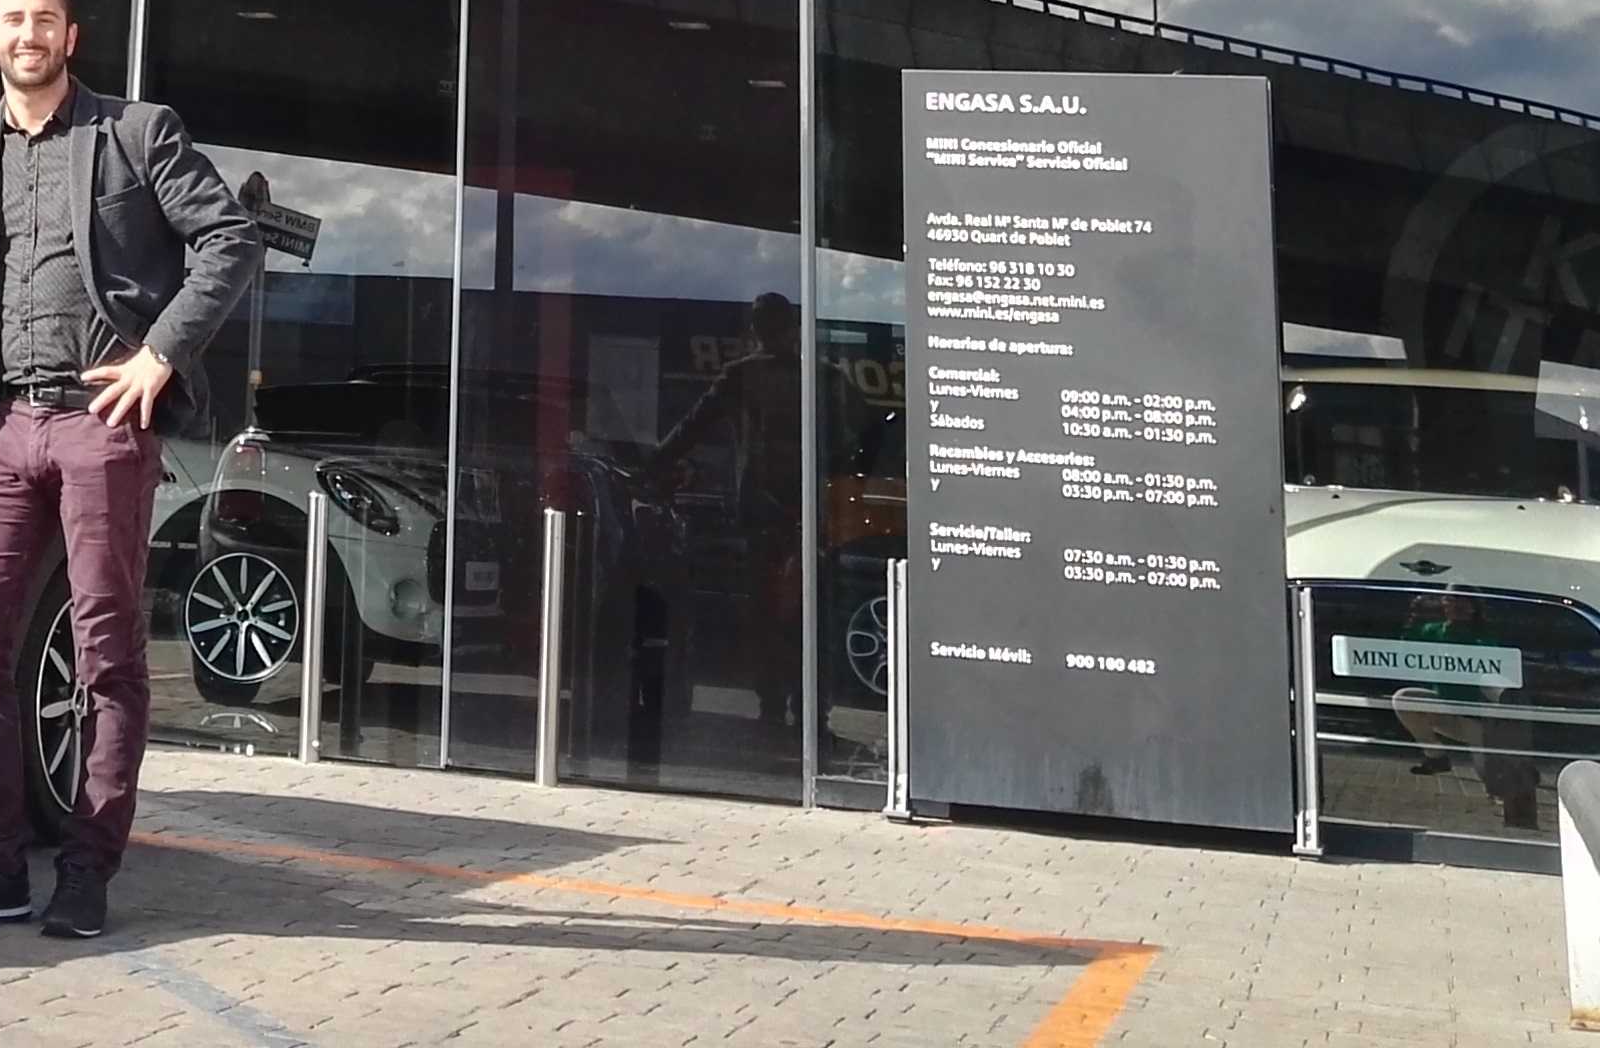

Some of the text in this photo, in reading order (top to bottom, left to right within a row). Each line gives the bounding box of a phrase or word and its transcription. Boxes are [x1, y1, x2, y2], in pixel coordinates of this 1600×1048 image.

[925, 91, 1087, 115] ENGASA S.A.U.
[925, 136, 1103, 155] MINI Concesionario Oficial
[1026, 155, 1081, 170] Servicio
[1082, 157, 1129, 171] Oficial
[926, 211, 963, 227] Avda.
[964, 213, 993, 227] Real
[1012, 215, 1050, 230] Santa
[1070, 217, 1089, 232] de
[1090, 218, 1133, 234] Poblet
[1133, 219, 1153, 233] 74
[926, 227, 1071, 247] 46930 Quart de Poblet
[927, 257, 1075, 277] Teléfono: 96 318 10 30
[927, 272, 1041, 291] Fax: 96 152 22 30
[927, 305, 1060, 325] www.mini.es/engasa
[927, 335, 1074, 356] Horarios de apertura:
[928, 365, 1001, 383] Comercial:
[928, 381, 1019, 400] Lunes-Viernes
[1060, 389, 1101, 405] 09:00
[1101, 393, 1132, 407] a.m.
[1142, 394, 1183, 409] 02:00
[1184, 398, 1217, 413] p.m.
[929, 413, 985, 430] Sábados
[1061, 405, 1101, 420] 04:00
[1101, 409, 1133, 423] p.m.
[1143, 410, 1184, 425] 08:00
[1185, 414, 1217, 428] p.m.
[1062, 422, 1101, 437] 10:30
[1102, 426, 1133, 439] a.m.
[1143, 426, 1184, 442] 01:30
[1185, 431, 1217, 445] p.m.
[929, 443, 1005, 462] Recambios
[1016, 448, 1095, 467] Accesorios:
[929, 459, 1021, 479] Lunes-Viernes
[1061, 468, 1102, 484] 08:00
[1103, 472, 1134, 486] a.m.
[1144, 473, 1185, 489] 01:30
[1186, 477, 1218, 492] p.m.
[1062, 483, 1102, 500] 03:30
[1103, 488, 1134, 503] p.m.
[1144, 488, 1186, 505] 07:00
[1186, 493, 1219, 508] p.m.
[929, 522, 1032, 543] Servicio/Taller:
[930, 538, 1022, 559] Lunes-Viernes
[1063, 548, 1104, 564] 07:30
[1104, 553, 1136, 567] a.m.
[1146, 553, 1188, 570] 01:30
[1188, 559, 1221, 573] p.m.
[1064, 565, 1104, 582] 03:30
[1105, 570, 1137, 585] p.m.
[1147, 571, 1188, 587] 07:00
[1189, 576, 1221, 591] p.m.
[930, 641, 1156, 675] Servicio Móvil: 900 100 482
[1353, 650, 1502, 675] MINI CLUBMAN
